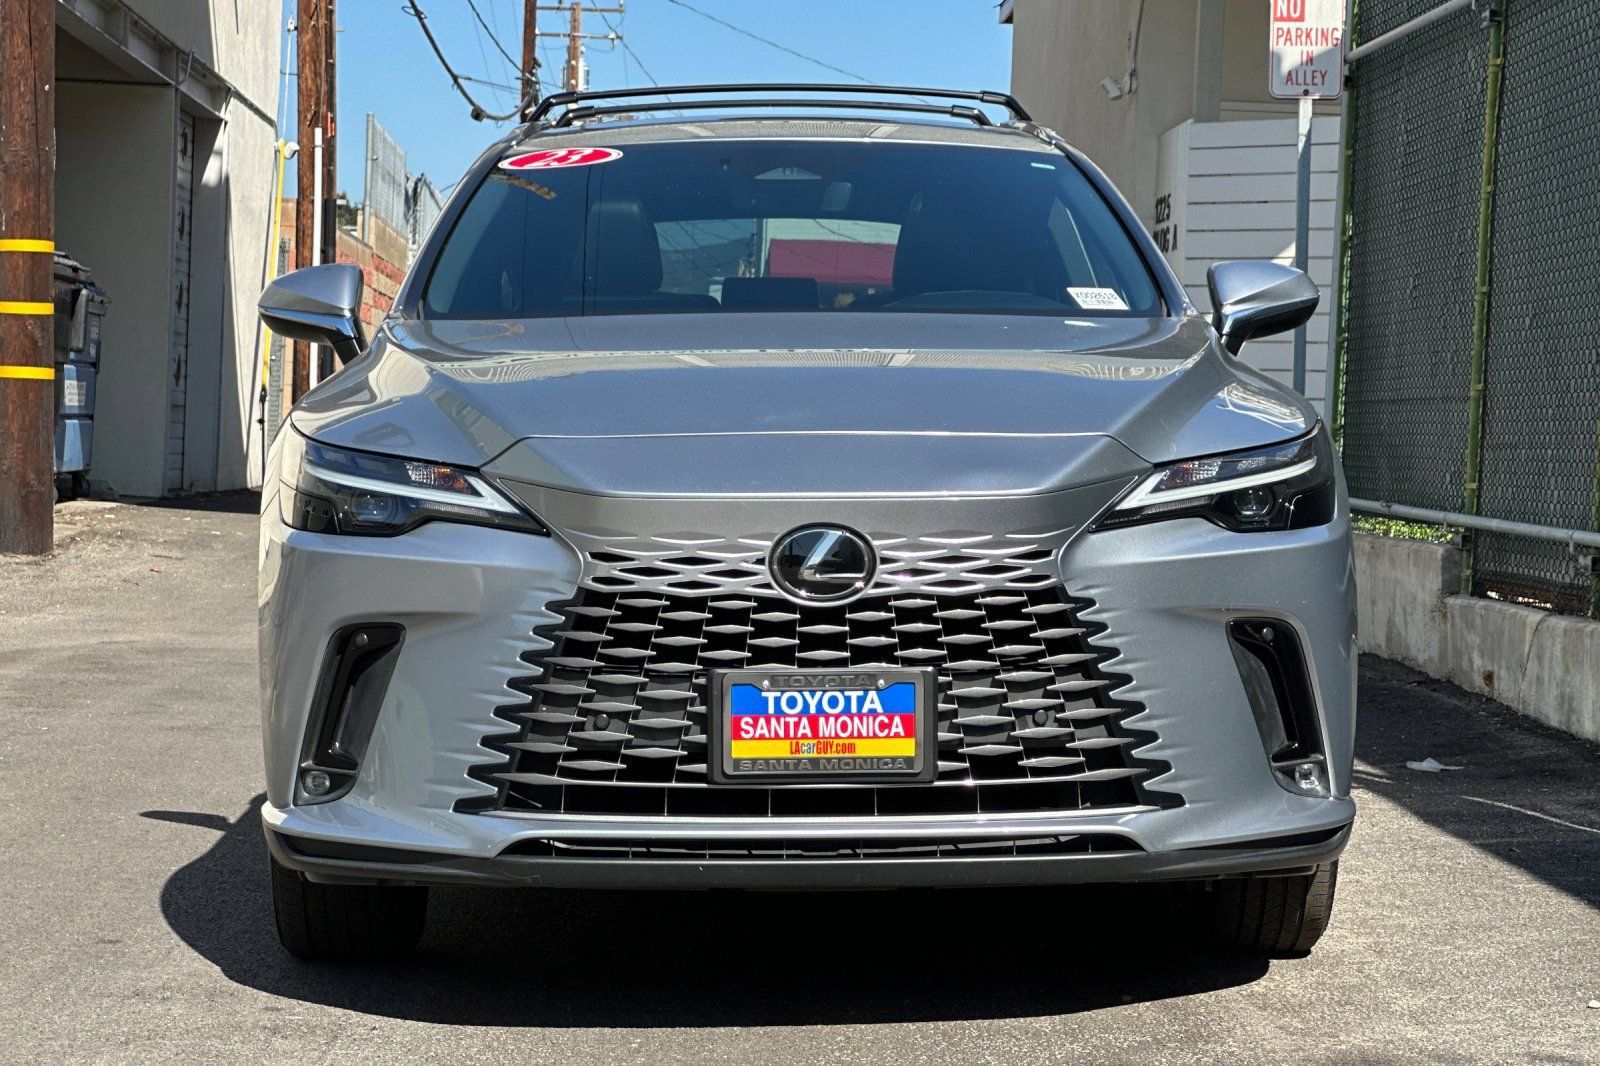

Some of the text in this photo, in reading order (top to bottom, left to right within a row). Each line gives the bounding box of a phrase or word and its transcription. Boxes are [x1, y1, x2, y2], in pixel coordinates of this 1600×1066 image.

[1277, 0, 1302, 18] NO
[1276, 27, 1340, 47] PARKING
[1300, 50, 1314, 67] IN
[1285, 69, 1329, 87] ALLEY
[1172, 223, 1178, 251] A
[774, 674, 873, 688] TOYOTA
[761, 690, 884, 715] TOYOTA
[740, 715, 905, 739] SANTA MONICA
[789, 740, 857, 755] LAcarGUY.com
[739, 758, 908, 771] SANTA MONICA
